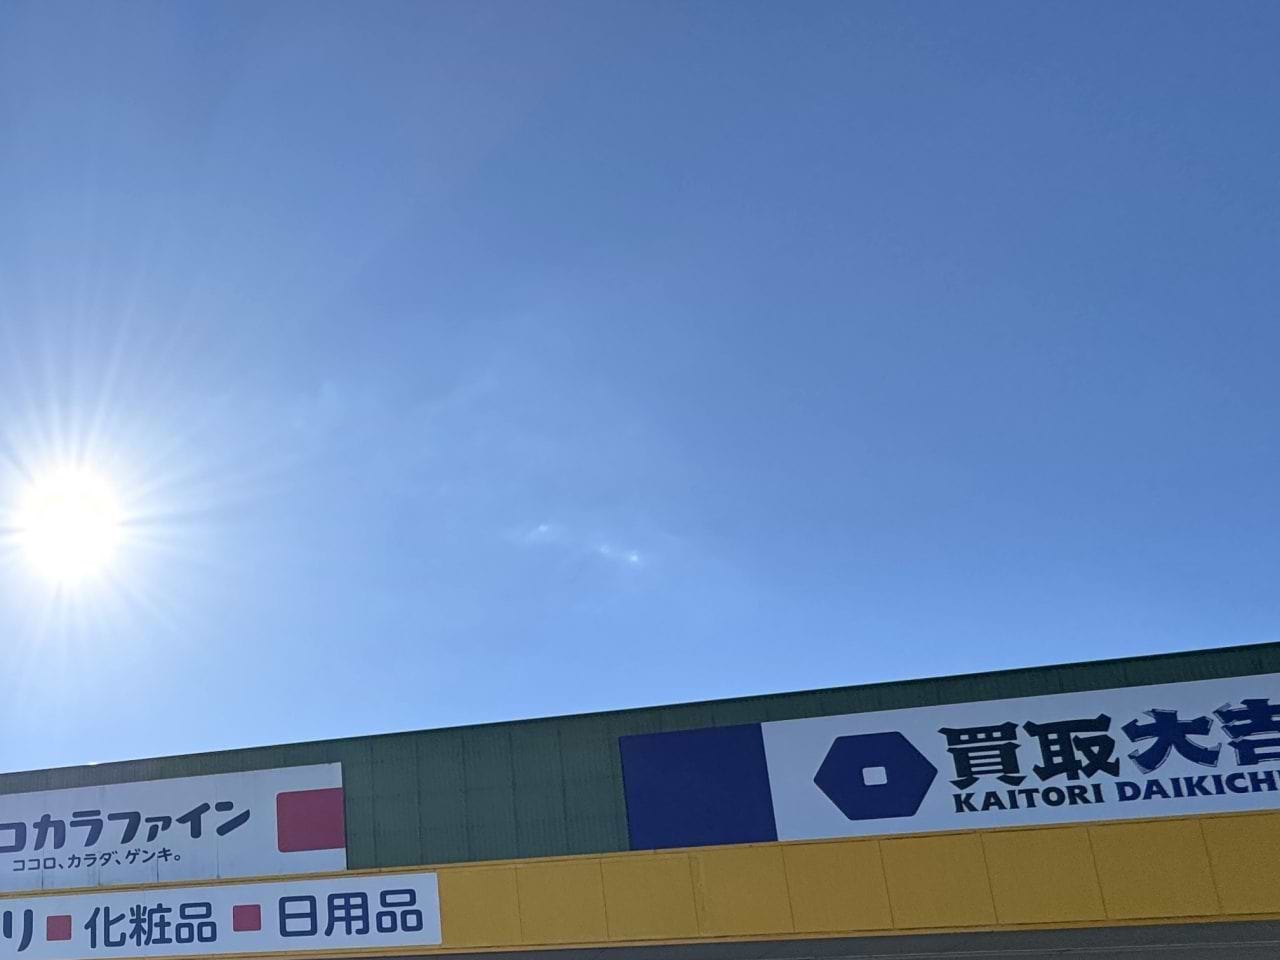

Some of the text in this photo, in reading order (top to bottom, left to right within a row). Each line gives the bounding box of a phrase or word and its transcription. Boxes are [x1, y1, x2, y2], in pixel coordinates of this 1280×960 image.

[937, 697, 1280, 790] 買取大吉
[953, 769, 1280, 814] KAITORI DAIKICH
[12, 847, 182, 872] ココロ、カラダ、ゲンキ。
[83, 901, 219, 951] 化粧品
[277, 887, 424, 938] 日用品
